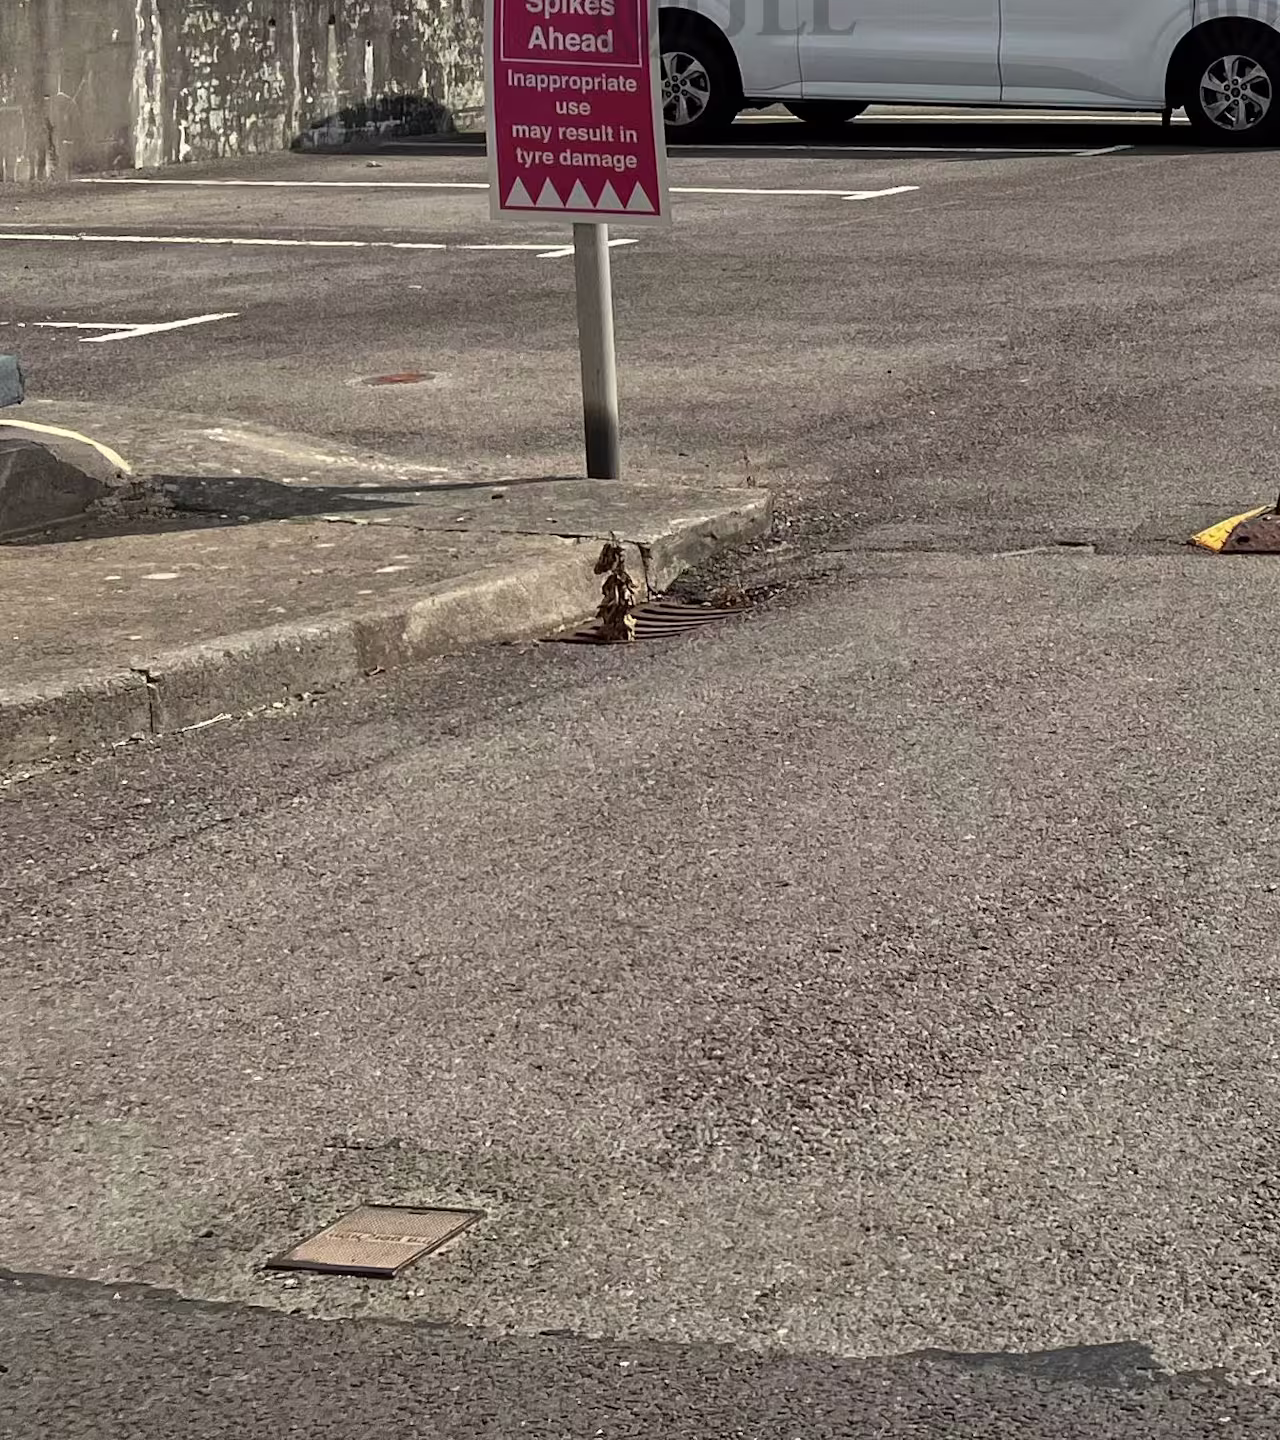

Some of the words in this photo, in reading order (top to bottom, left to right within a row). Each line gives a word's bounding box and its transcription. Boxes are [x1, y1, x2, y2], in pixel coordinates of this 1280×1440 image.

[528, 25, 613, 54] Ahead
[508, 69, 637, 94] Inappropriate
[555, 101, 591, 115] use
[512, 124, 552, 143] may
[559, 125, 614, 142] result
[620, 126, 637, 143] in
[516, 147, 553, 168] tyre
[559, 149, 637, 172] damage
